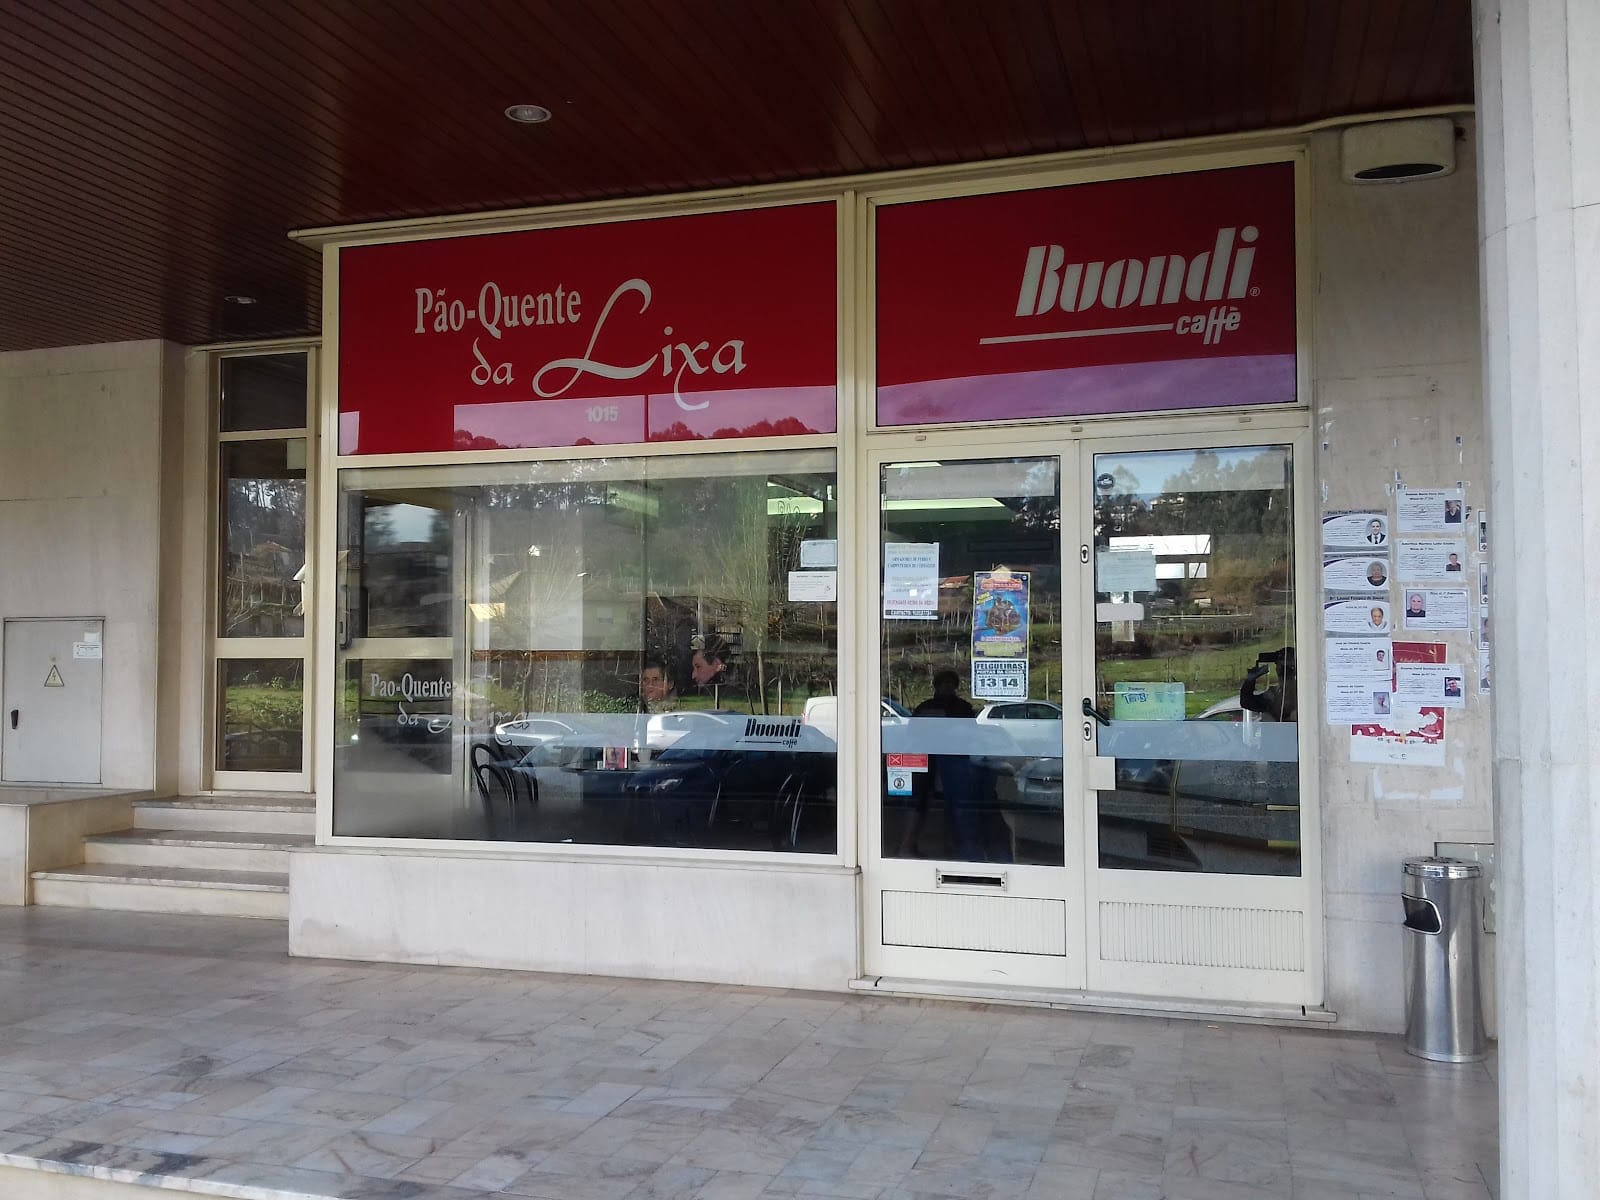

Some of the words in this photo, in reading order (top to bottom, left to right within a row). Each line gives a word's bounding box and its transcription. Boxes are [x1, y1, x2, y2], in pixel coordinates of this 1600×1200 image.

[1016, 226, 1260, 317] Buondi
[414, 281, 581, 339] Pão-Quente
[1176, 306, 1241, 345] caffè
[470, 337, 515, 386] da
[532, 278, 747, 411] Lixa
[585, 406, 619, 422] 1015
[979, 678, 997, 688] 13
[1000, 678, 1019, 688] 14
[396, 701, 419, 726] da
[744, 718, 801, 738] Buondi
